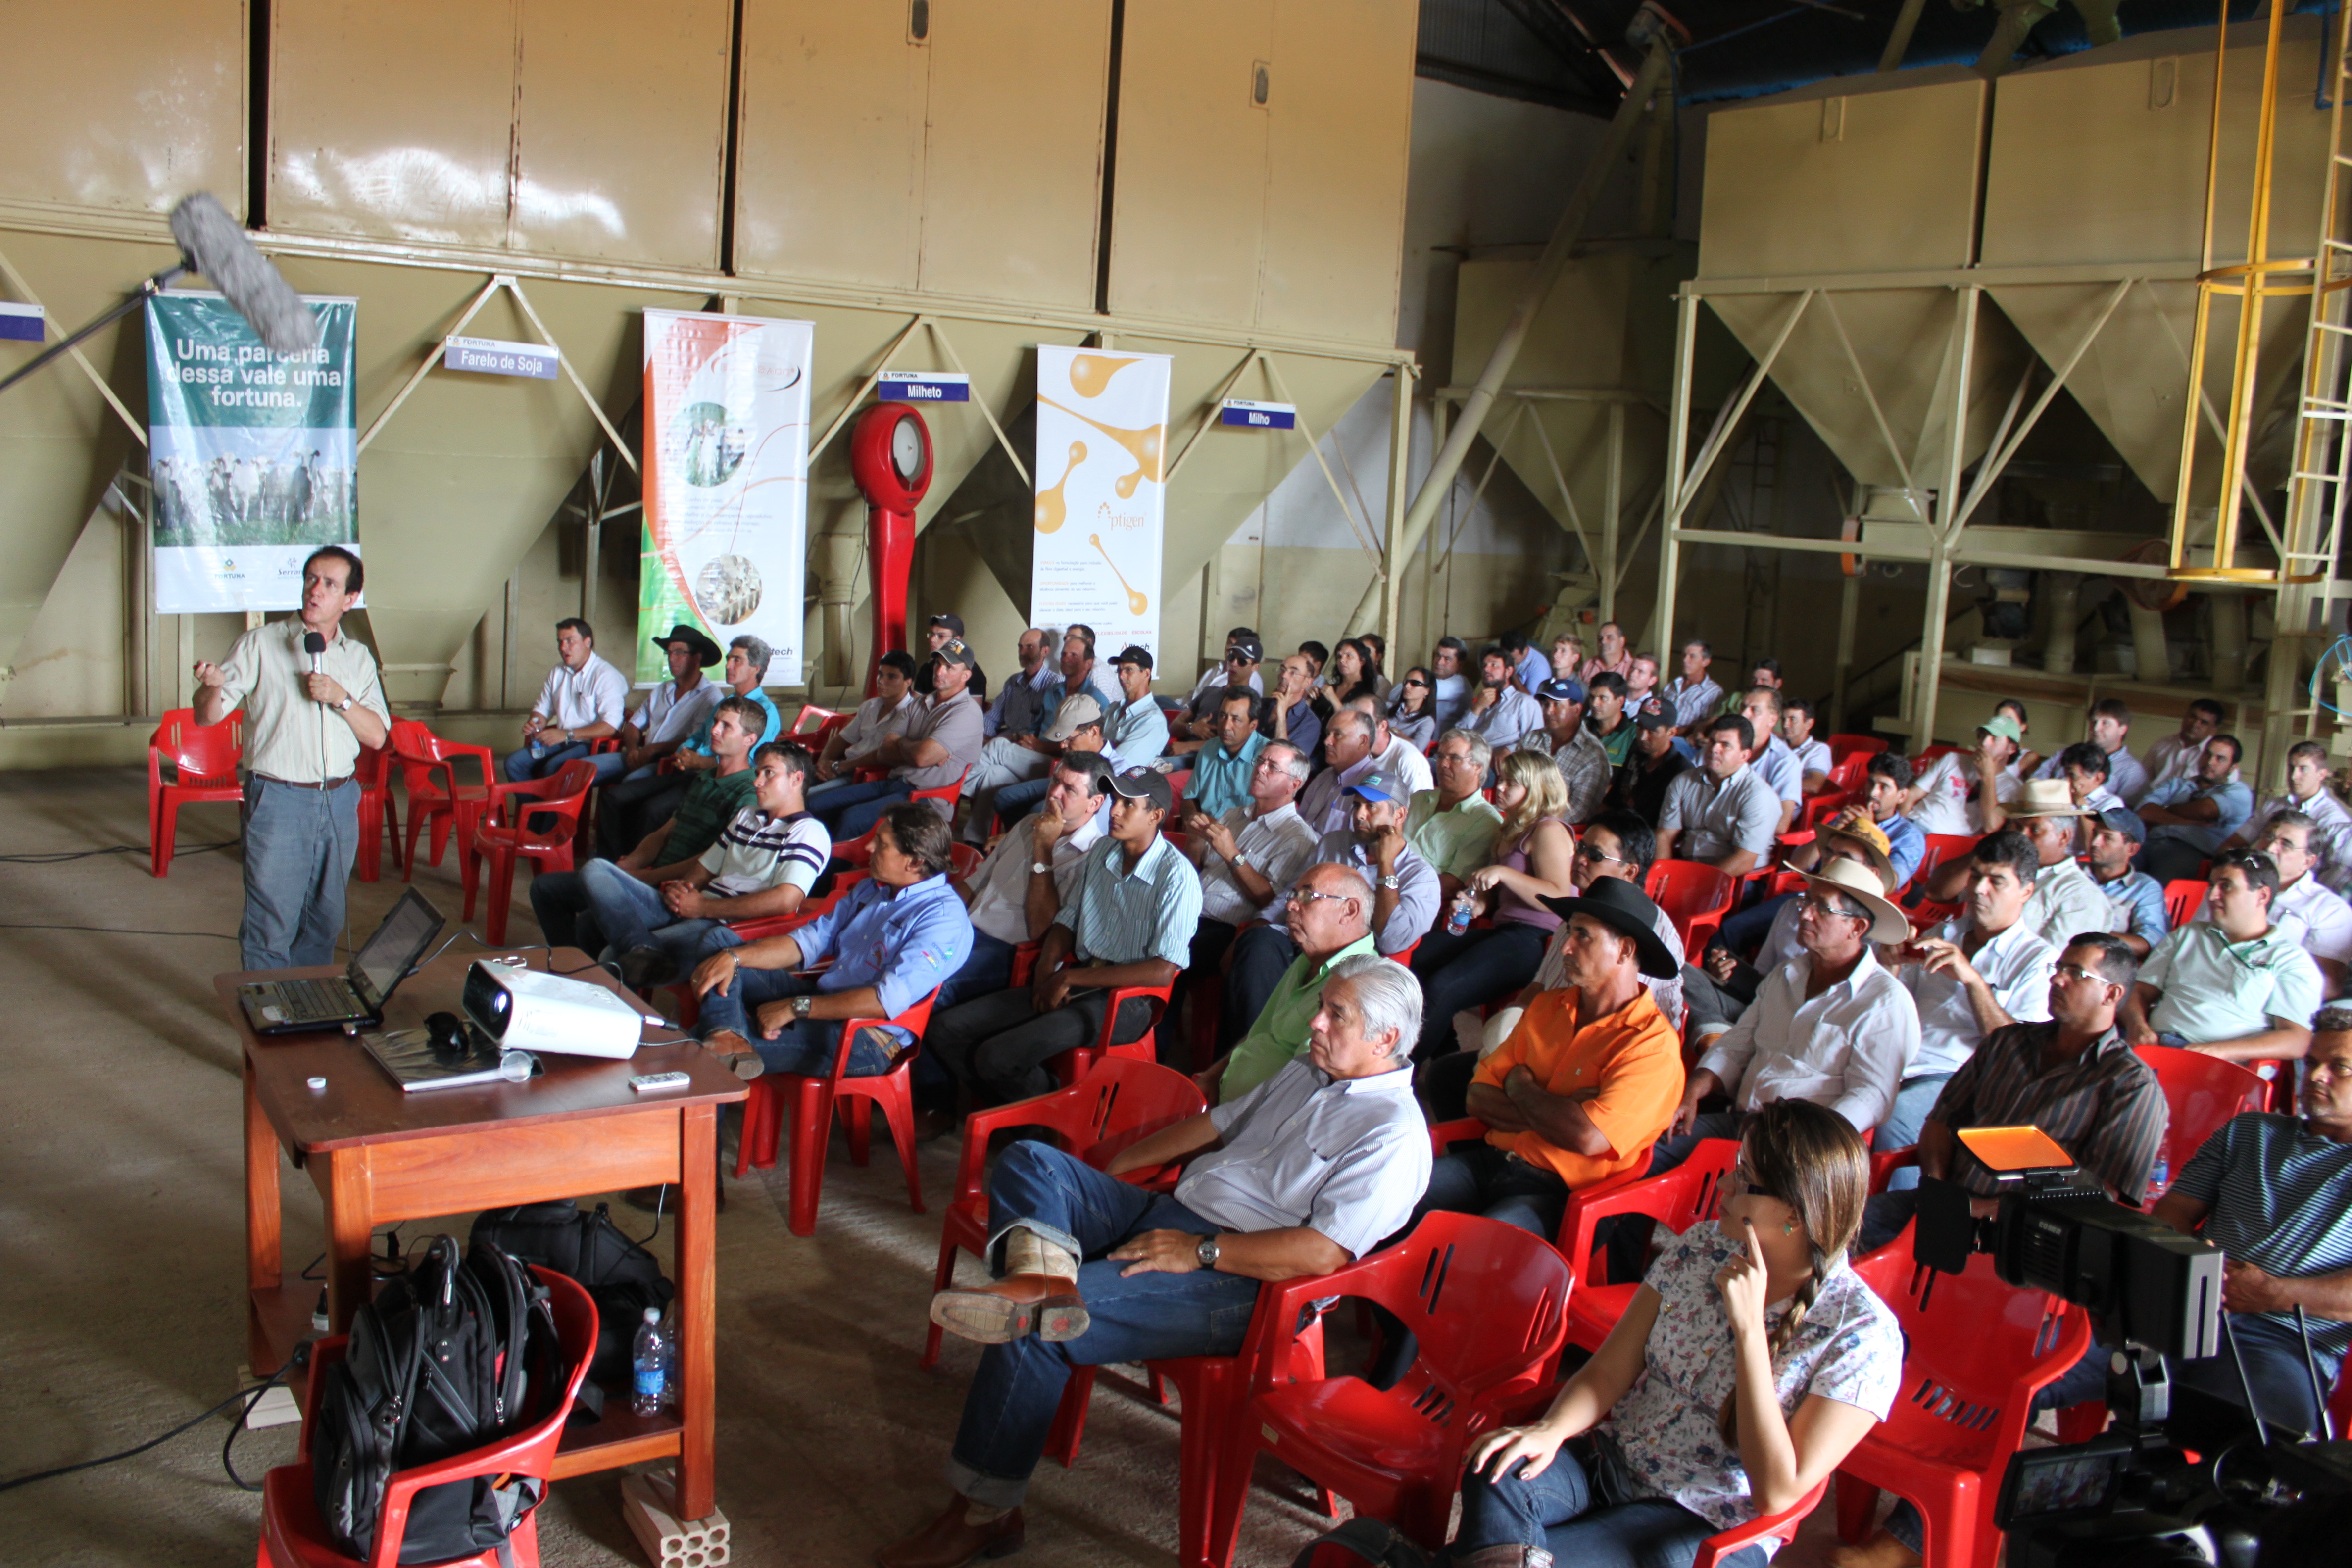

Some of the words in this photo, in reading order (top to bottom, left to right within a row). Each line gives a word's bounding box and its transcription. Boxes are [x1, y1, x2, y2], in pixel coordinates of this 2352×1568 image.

[177, 338, 230, 361] Uma
[463, 339, 495, 348] FORTUNA
[461, 349, 497, 368] Farelo
[500, 355, 515, 370] de
[518, 356, 543, 376] Soja
[167, 361, 233, 384] dessa
[239, 364, 286, 385] vale
[294, 370, 341, 387] uma
[211, 385, 301, 407] fortuna.
[907, 384, 942, 398] Milheto
[1248, 412, 1271, 425] Milho
[770, 647, 793, 656] tech
